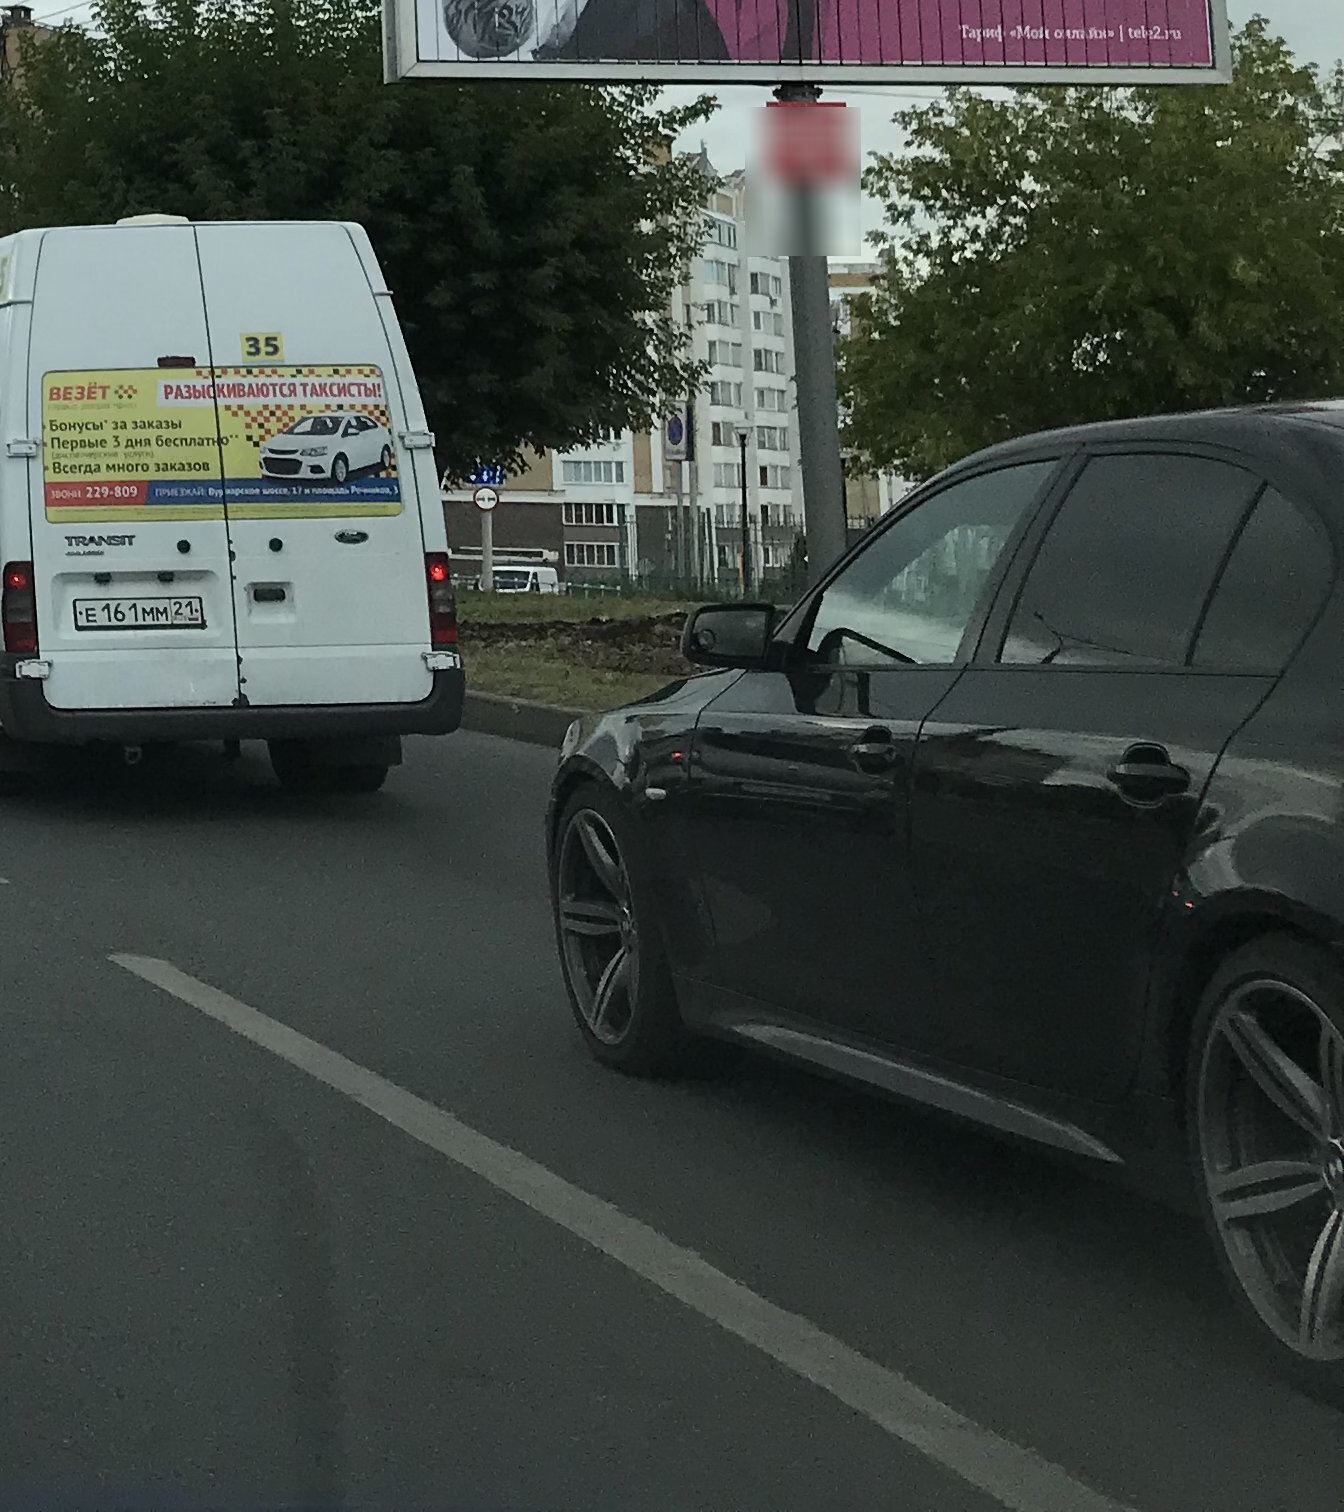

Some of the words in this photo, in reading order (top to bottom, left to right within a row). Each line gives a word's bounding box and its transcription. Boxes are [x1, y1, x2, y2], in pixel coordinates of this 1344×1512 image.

[245, 336, 280, 357] 35
[48, 381, 111, 401] ВЕЗЁТ
[163, 381, 298, 401] РАЗЫСКИВАЮТСЯ
[299, 381, 382, 399] ТАКСИСТЫ!
[111, 420, 128, 431] за
[131, 418, 183, 431] заказы
[50, 436, 108, 452] Первые
[112, 435, 121, 449] 3
[124, 436, 152, 449] дня
[52, 460, 101, 475] Всегда
[105, 461, 150, 473] много
[153, 459, 211, 473] заказов
[85, 485, 139, 499] 229-809
[64, 534, 136, 547] TRANSIT
[173, 600, 194, 616] 21
